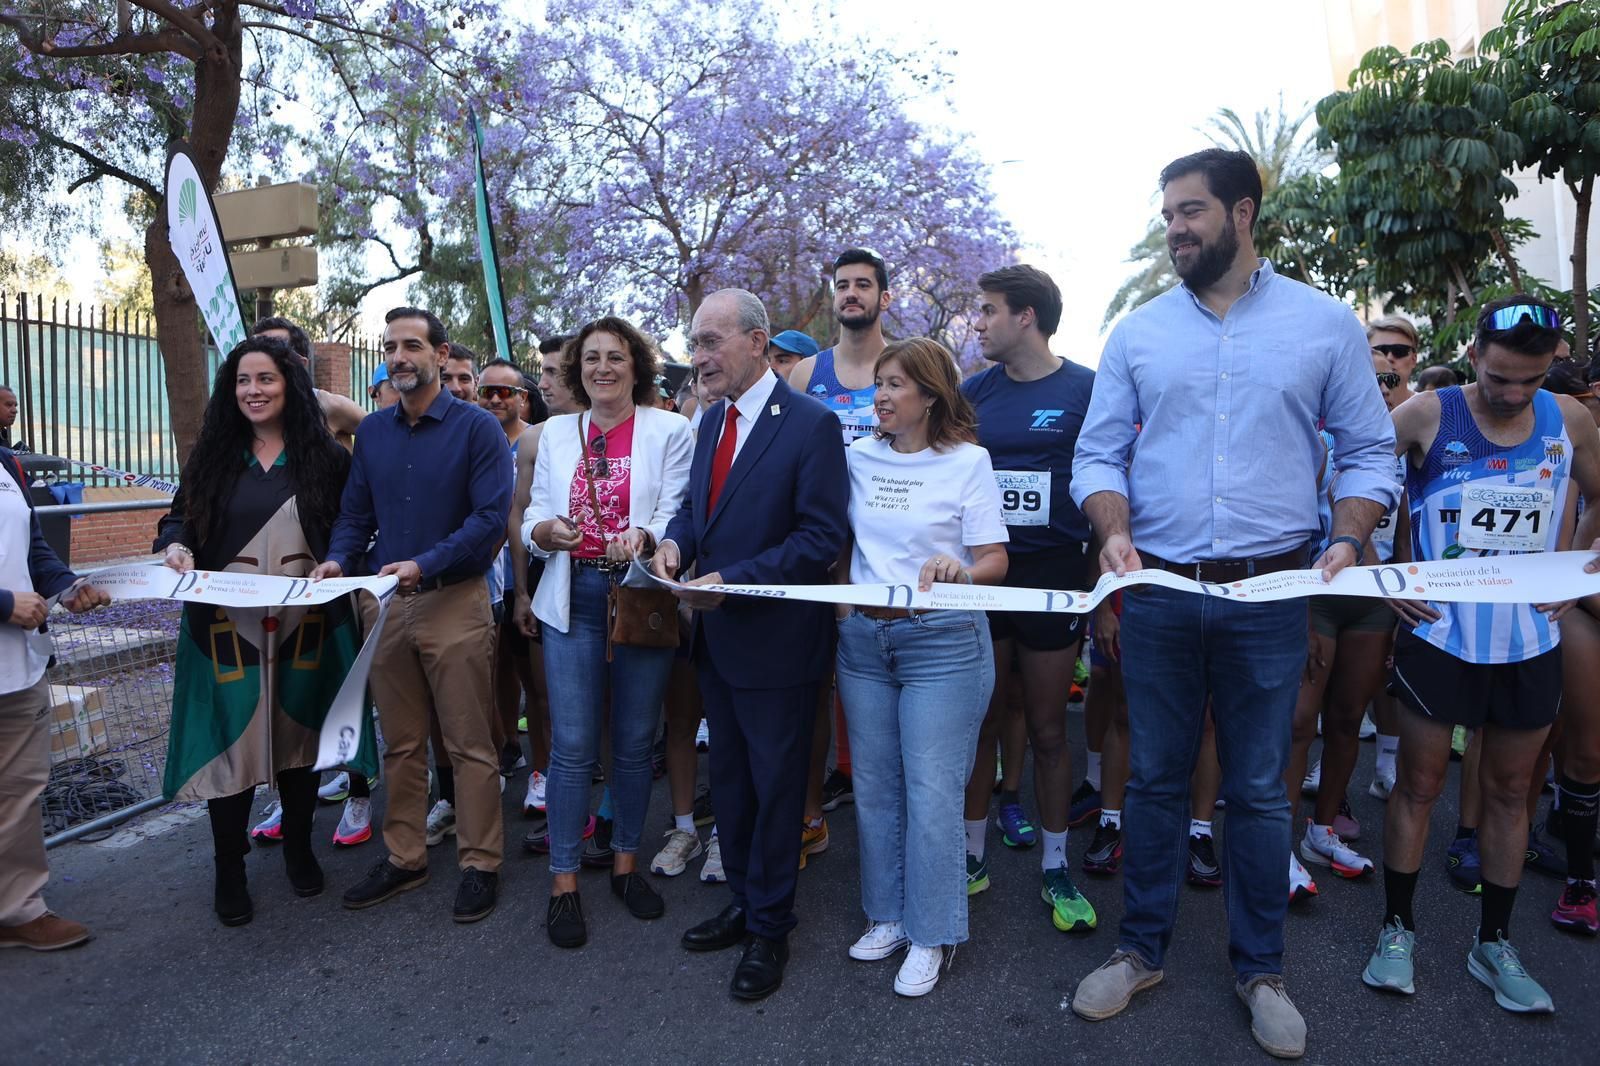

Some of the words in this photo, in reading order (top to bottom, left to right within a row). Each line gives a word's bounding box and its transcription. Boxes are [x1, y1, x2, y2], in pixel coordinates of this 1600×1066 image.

[1442, 468, 1471, 480] vive
[871, 475, 886, 483] Girls
[887, 477, 909, 486] should
[909, 479, 924, 487] play
[865, 500, 879, 508] THEY
[874, 495, 908, 503] WHATEVER
[1471, 508, 1541, 534] 471
[1426, 567, 1476, 579] Asociación
[1475, 566, 1490, 576] de
[1491, 565, 1501, 575] la
[1427, 580, 1461, 588] Prensa
[1463, 579, 1475, 587] de
[1477, 578, 1514, 587] Málaga
[207, 584, 228, 593] Prensa
[1250, 584, 1283, 594] Prensa
[931, 591, 975, 601] Asociación
[975, 592, 987, 601] de
[987, 592, 995, 601] la
